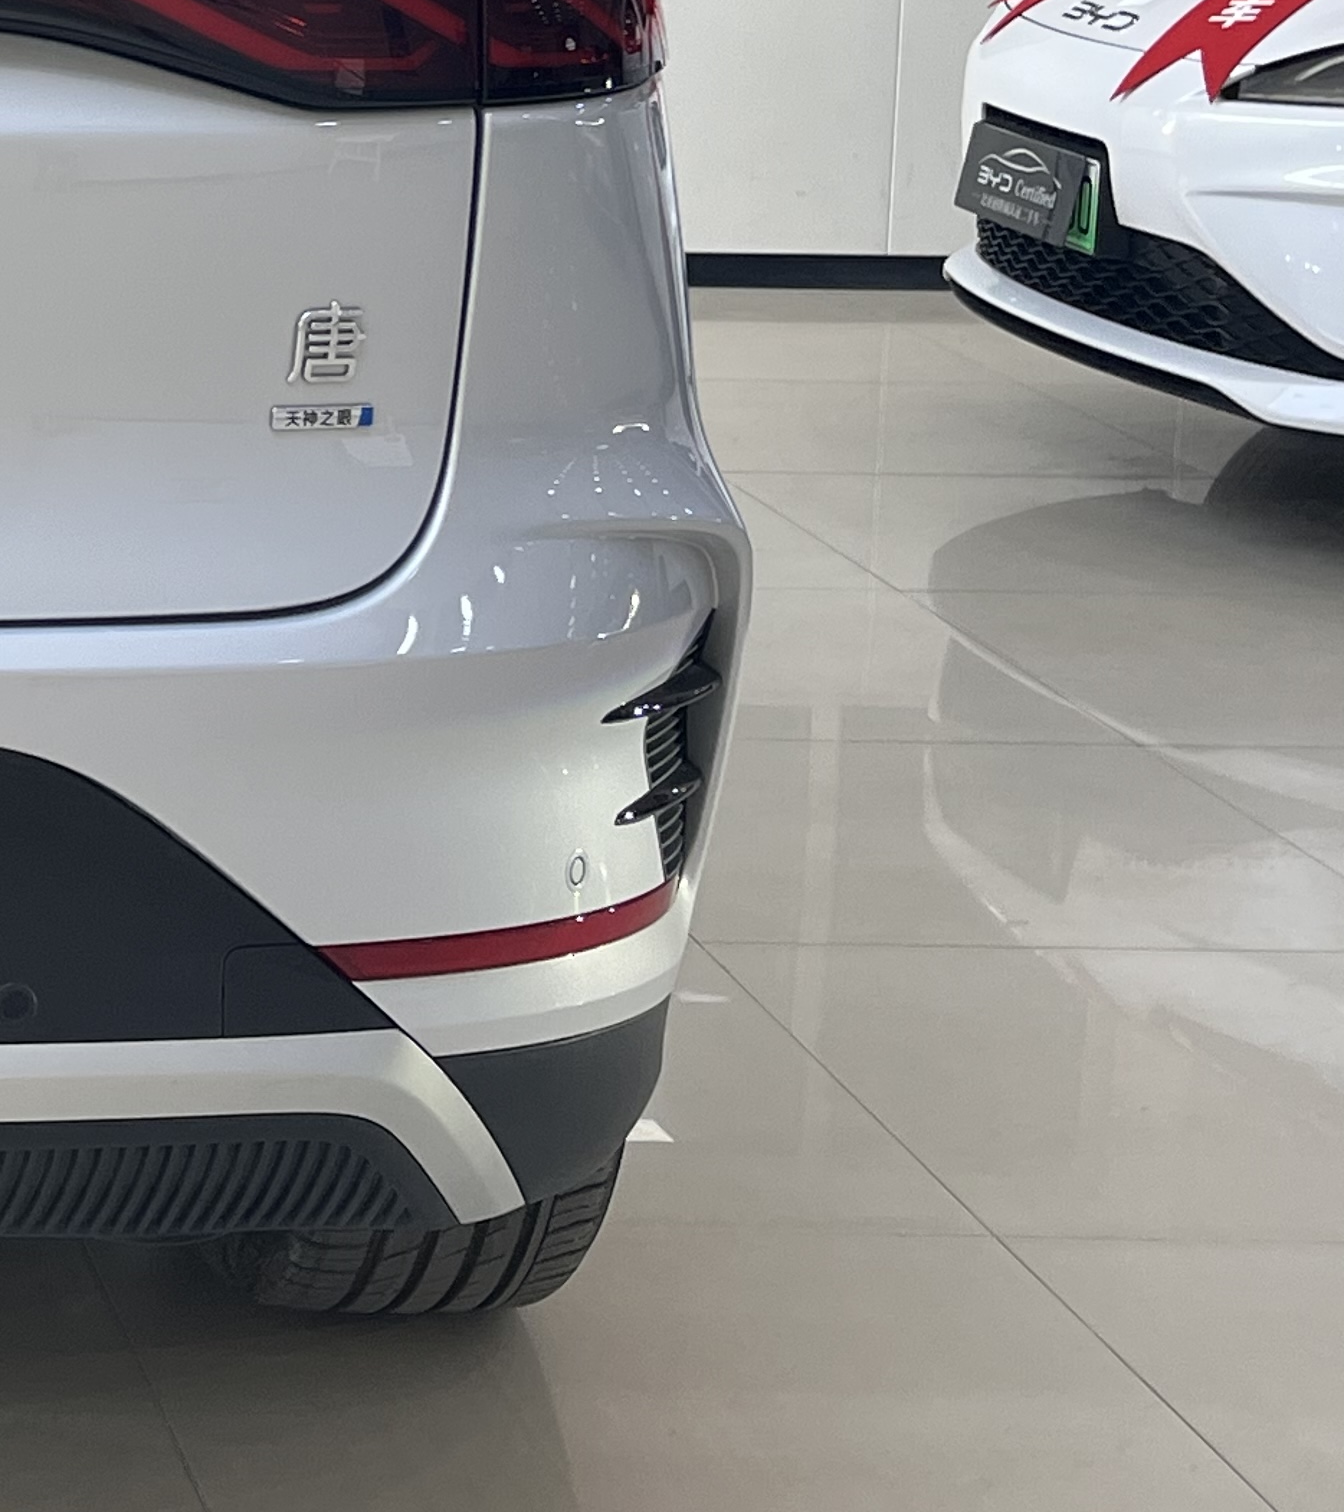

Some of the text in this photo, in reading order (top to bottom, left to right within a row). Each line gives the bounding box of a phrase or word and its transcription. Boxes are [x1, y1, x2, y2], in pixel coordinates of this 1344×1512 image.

[1061, 0, 1141, 32] BYD
[976, 164, 1014, 194] BYD
[1014, 178, 1057, 209] Certified
[286, 300, 367, 384] 唐
[284, 409, 353, 427] 天神之眼
